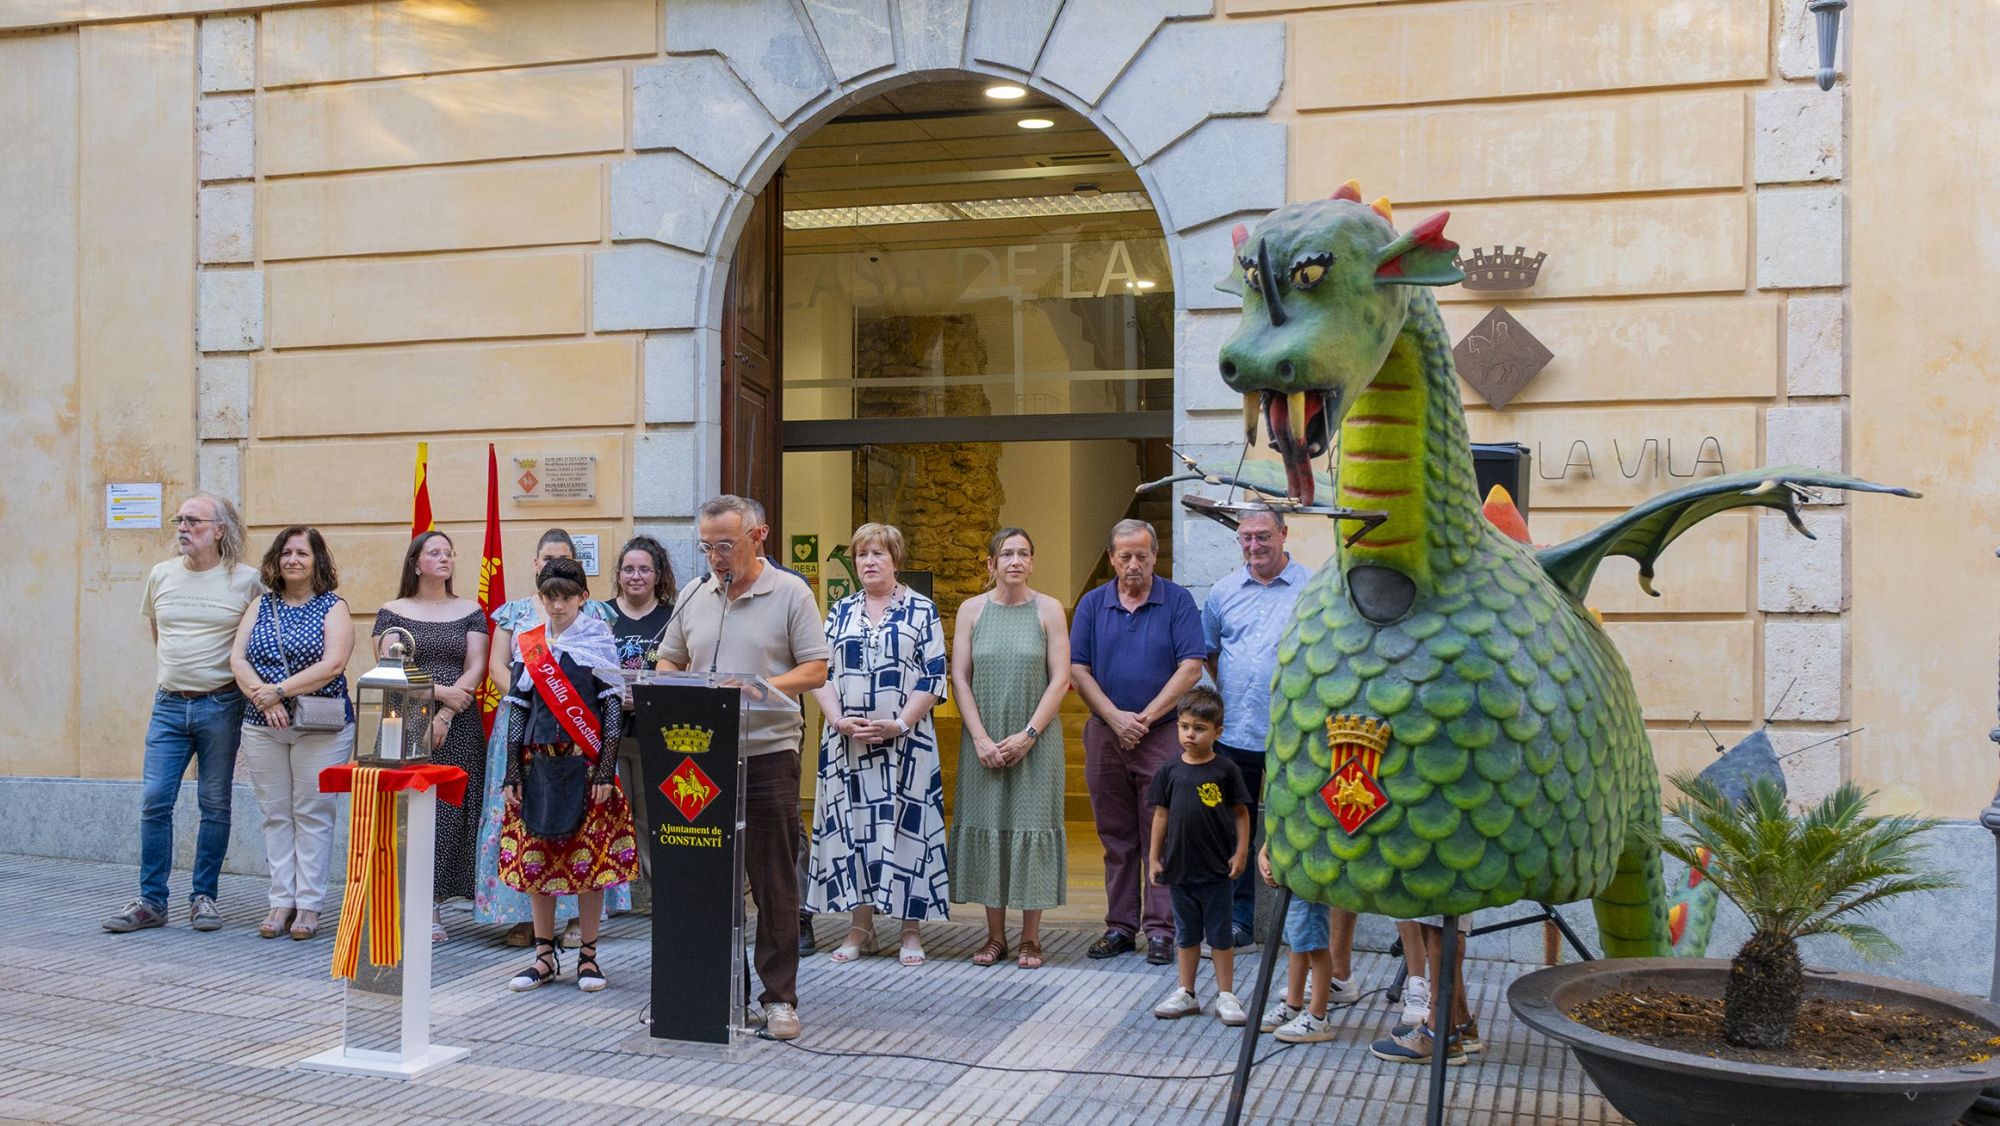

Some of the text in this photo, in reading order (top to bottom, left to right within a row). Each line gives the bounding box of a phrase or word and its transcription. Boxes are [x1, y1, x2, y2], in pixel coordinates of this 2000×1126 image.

[956, 244, 1039, 301] DE
[1062, 240, 1144, 298] LA
[1538, 436, 1727, 480] LA VILA
[794, 565, 817, 573] DESA
[565, 705, 603, 753] Constant
[660, 823, 722, 835] Ajuntament de
[660, 834, 722, 848] CONSTANTÍ
